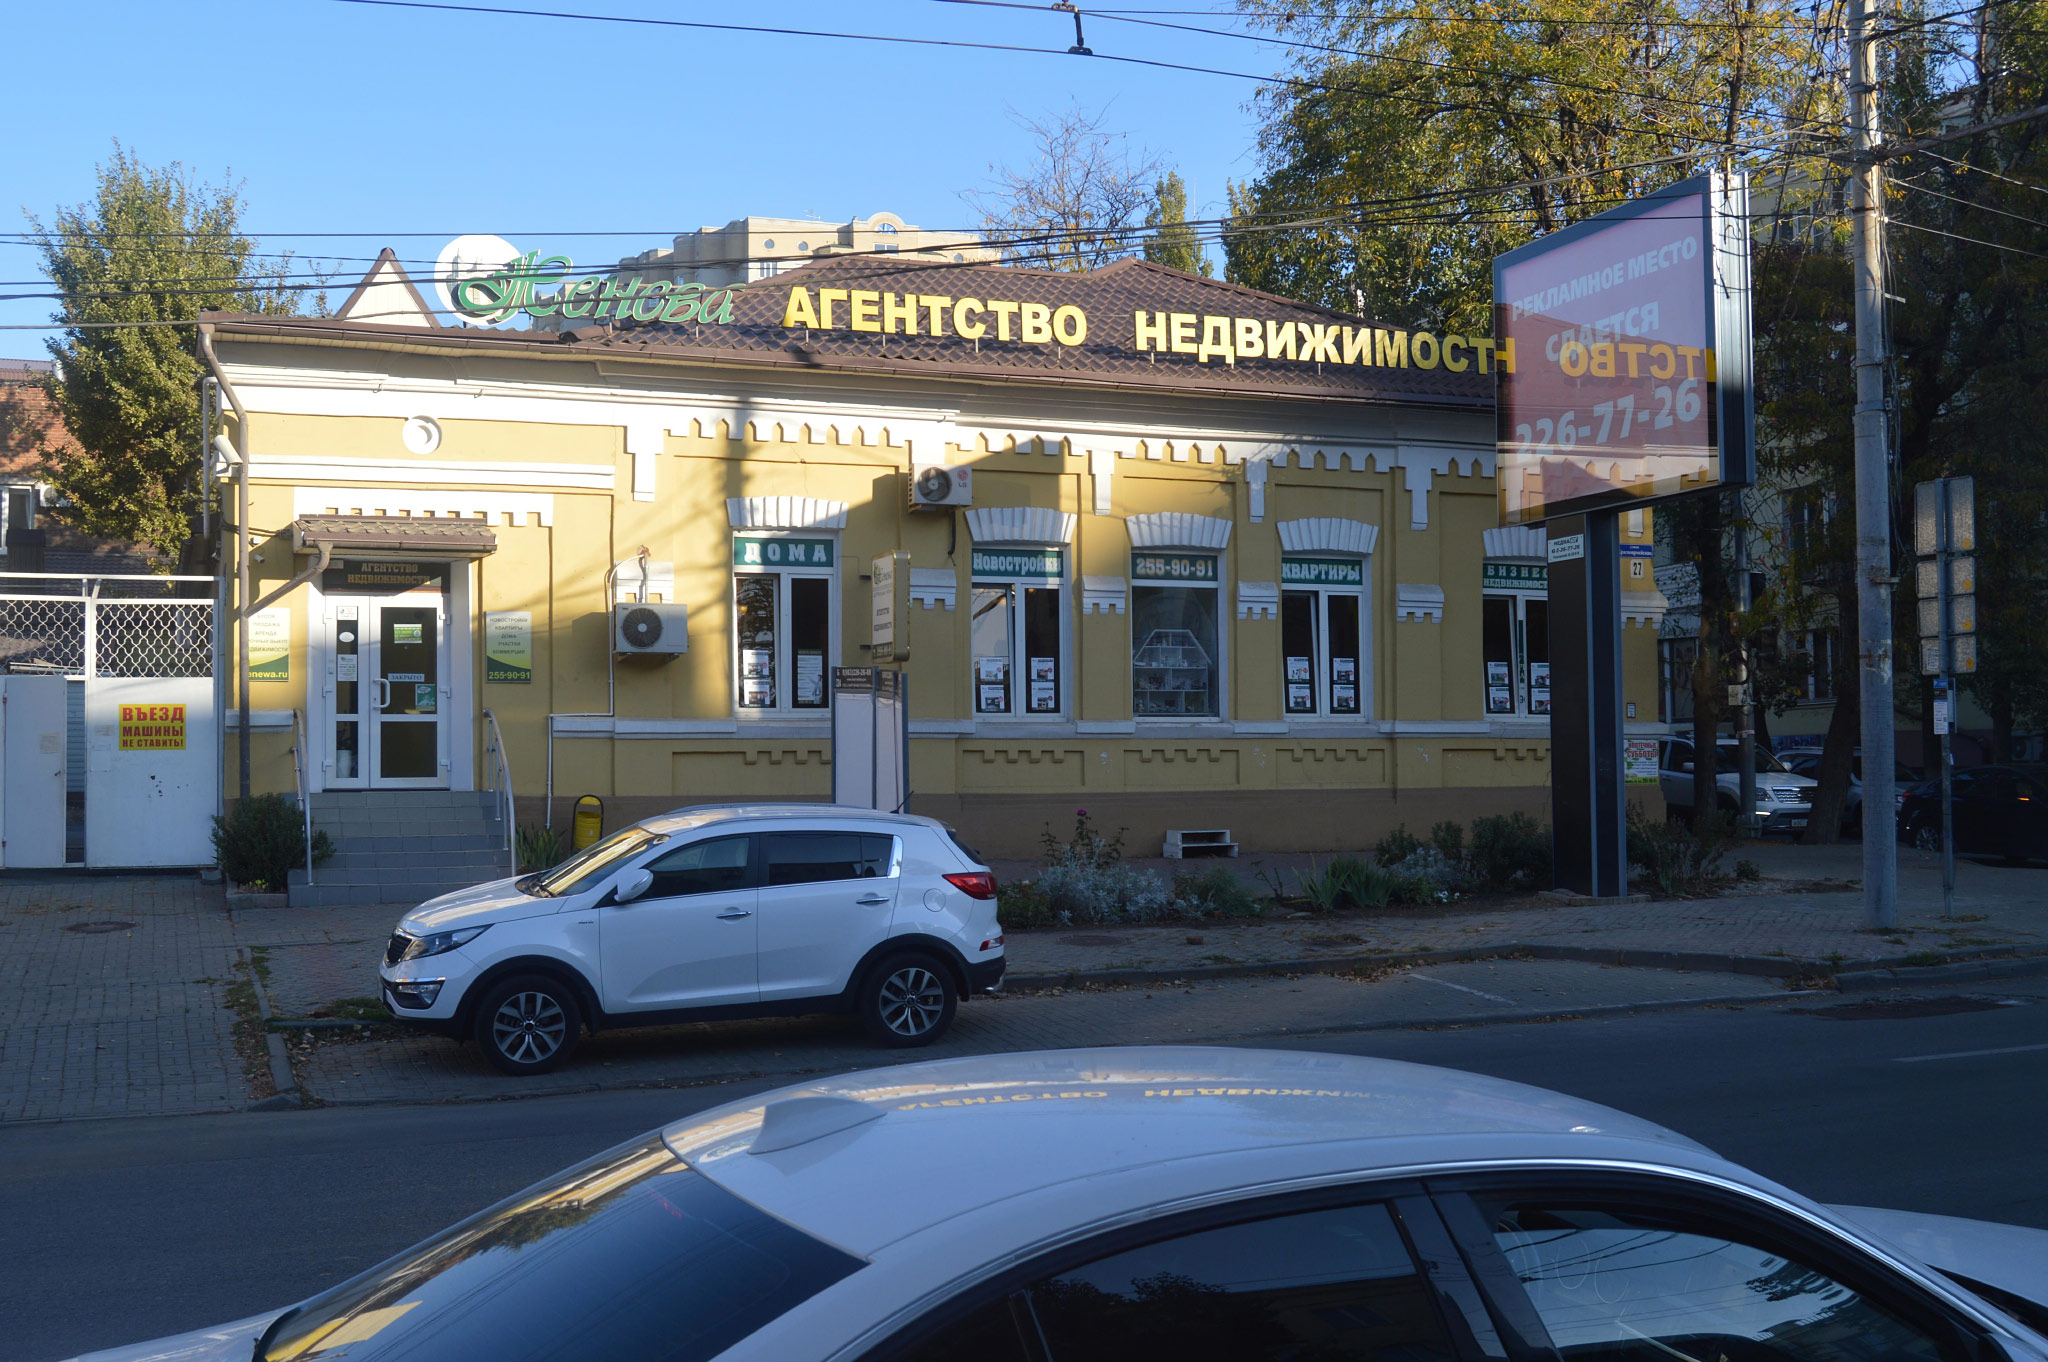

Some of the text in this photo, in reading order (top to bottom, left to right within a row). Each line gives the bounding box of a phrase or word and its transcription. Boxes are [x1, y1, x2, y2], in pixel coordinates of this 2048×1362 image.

[457, 249, 746, 324] Женева
[1512, 235, 1698, 321] РЕКЛАМНОЕ МЕСТО
[782, 286, 1088, 347] АГЕНТСТВО
[1134, 310, 1496, 375] НЕДВИЖИМОСТ
[1545, 301, 1660, 366] СДАЕТСЯ
[1515, 377, 1702, 464] 226-77-26
[744, 542, 827, 563] ДОМА
[361, 563, 418, 573] АГЕНТСТВО
[1136, 558, 1214, 577] 255-90-91
[1281, 563, 1361, 581] КВАРТИРЫ
[1633, 562, 1642, 576] 27
[347, 573, 430, 585] НЕДВИЖИМОСТИ
[1483, 578, 1548, 589] НЕДВИЖИМОСТ
[122, 707, 184, 724] ВЪЕЗД
[122, 726, 184, 737] МАШИНЫ
[122, 739, 184, 748] НЕ СТАВИТЬ!
[1627, 750, 1657, 758] СУББОТЫ
